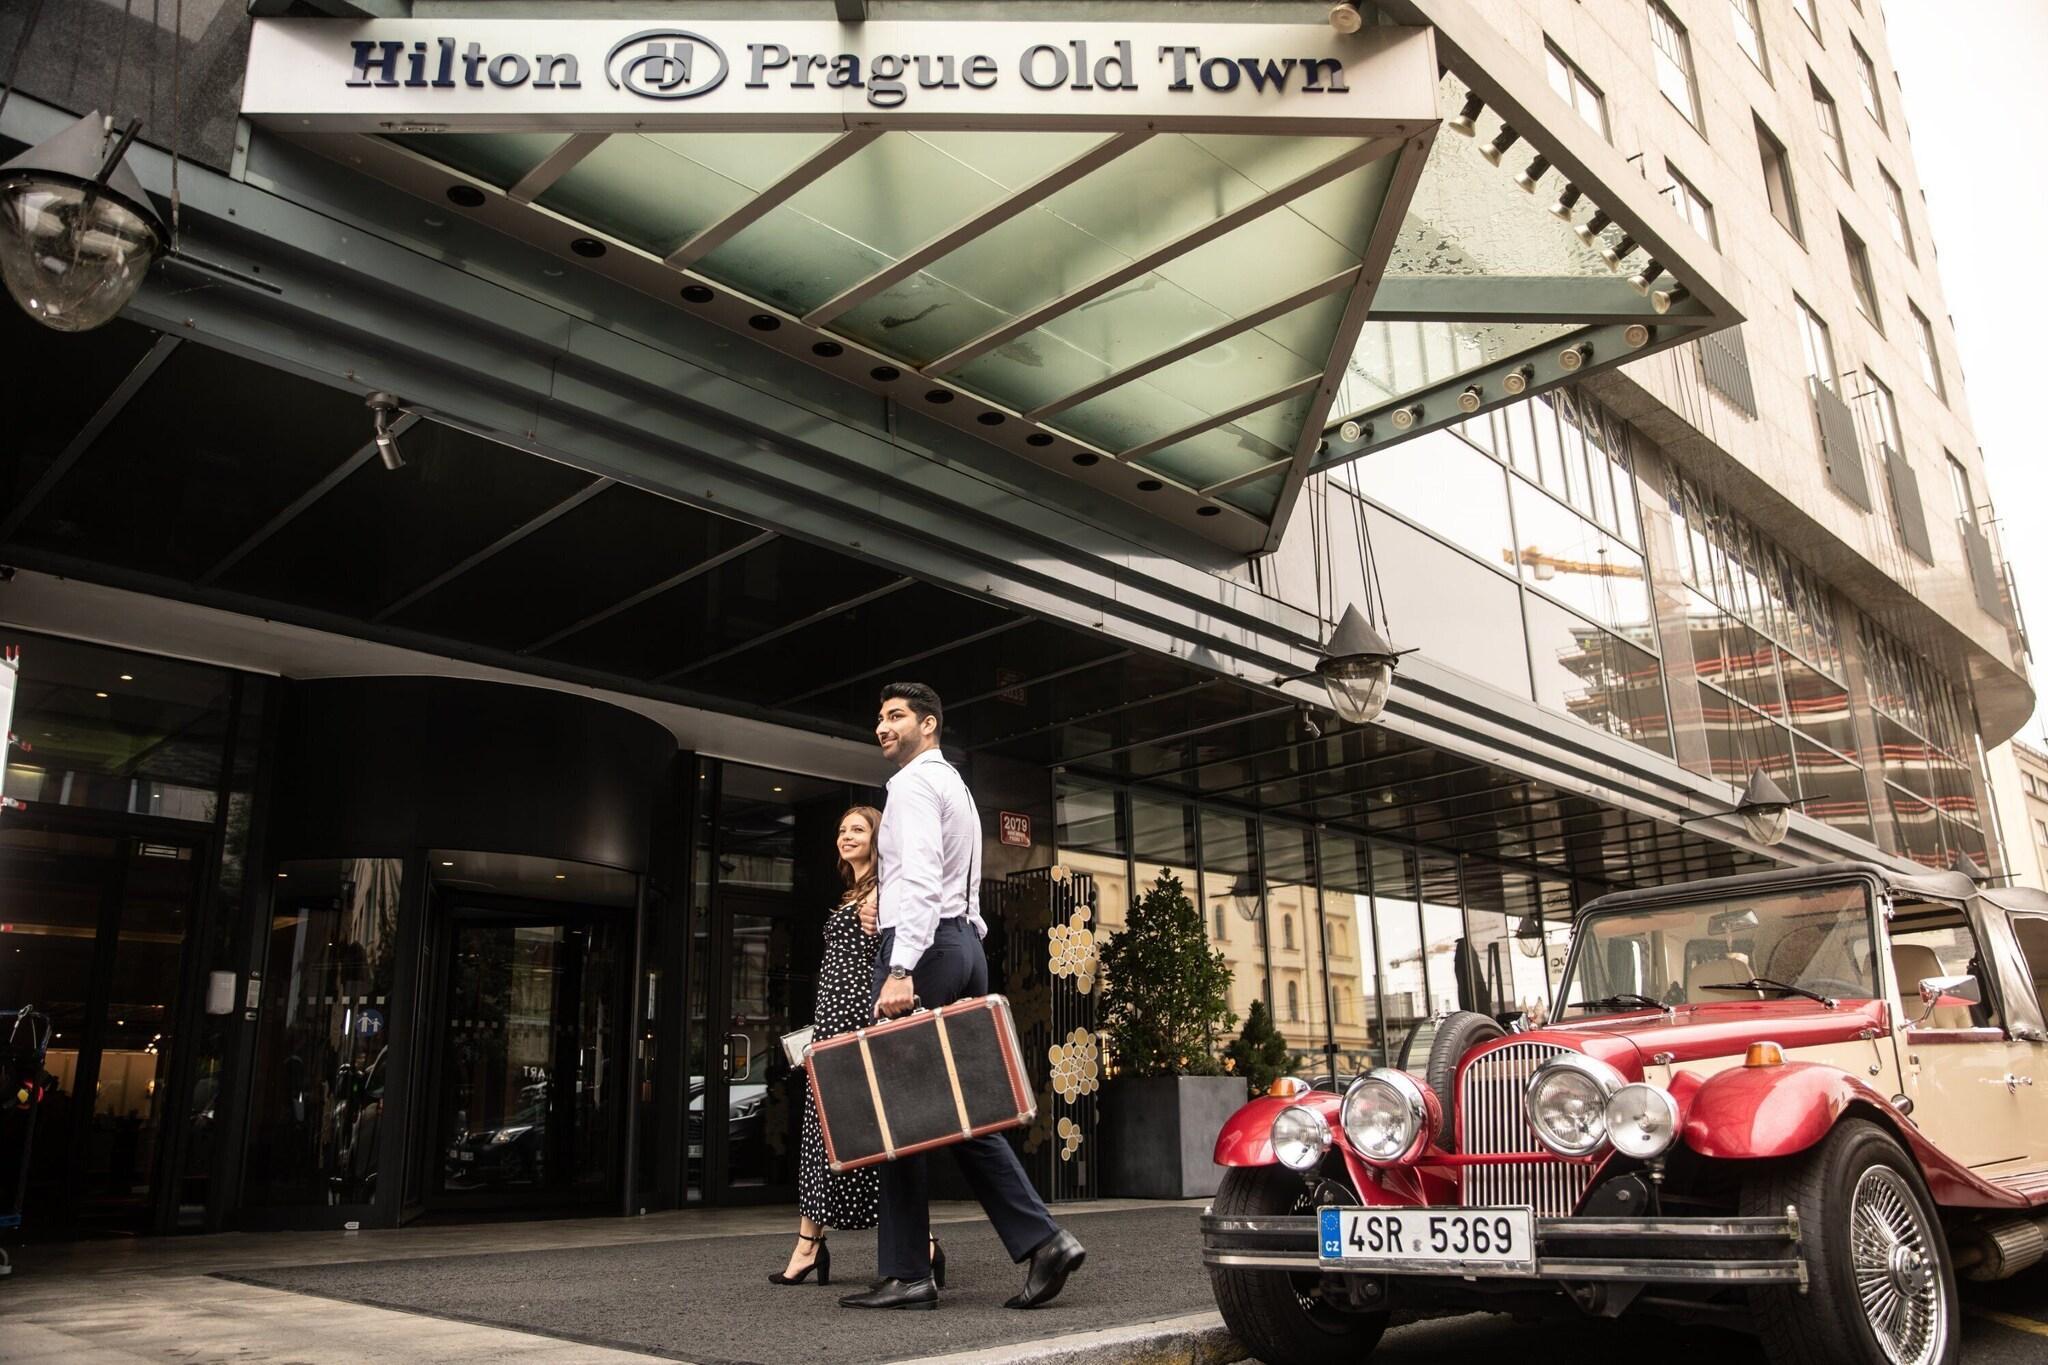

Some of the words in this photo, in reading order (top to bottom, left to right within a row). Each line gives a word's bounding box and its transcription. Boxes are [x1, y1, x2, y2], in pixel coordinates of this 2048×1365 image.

[345, 37, 581, 88] Hilton
[745, 43, 997, 108] Prague
[1019, 40, 1138, 91] Old
[1158, 46, 1349, 93] Town
[1004, 816, 1027, 832] 2079
[1325, 1241, 1339, 1251] CZ
[1349, 1216, 1403, 1252] 4SR
[1429, 1216, 1512, 1254] 5369
